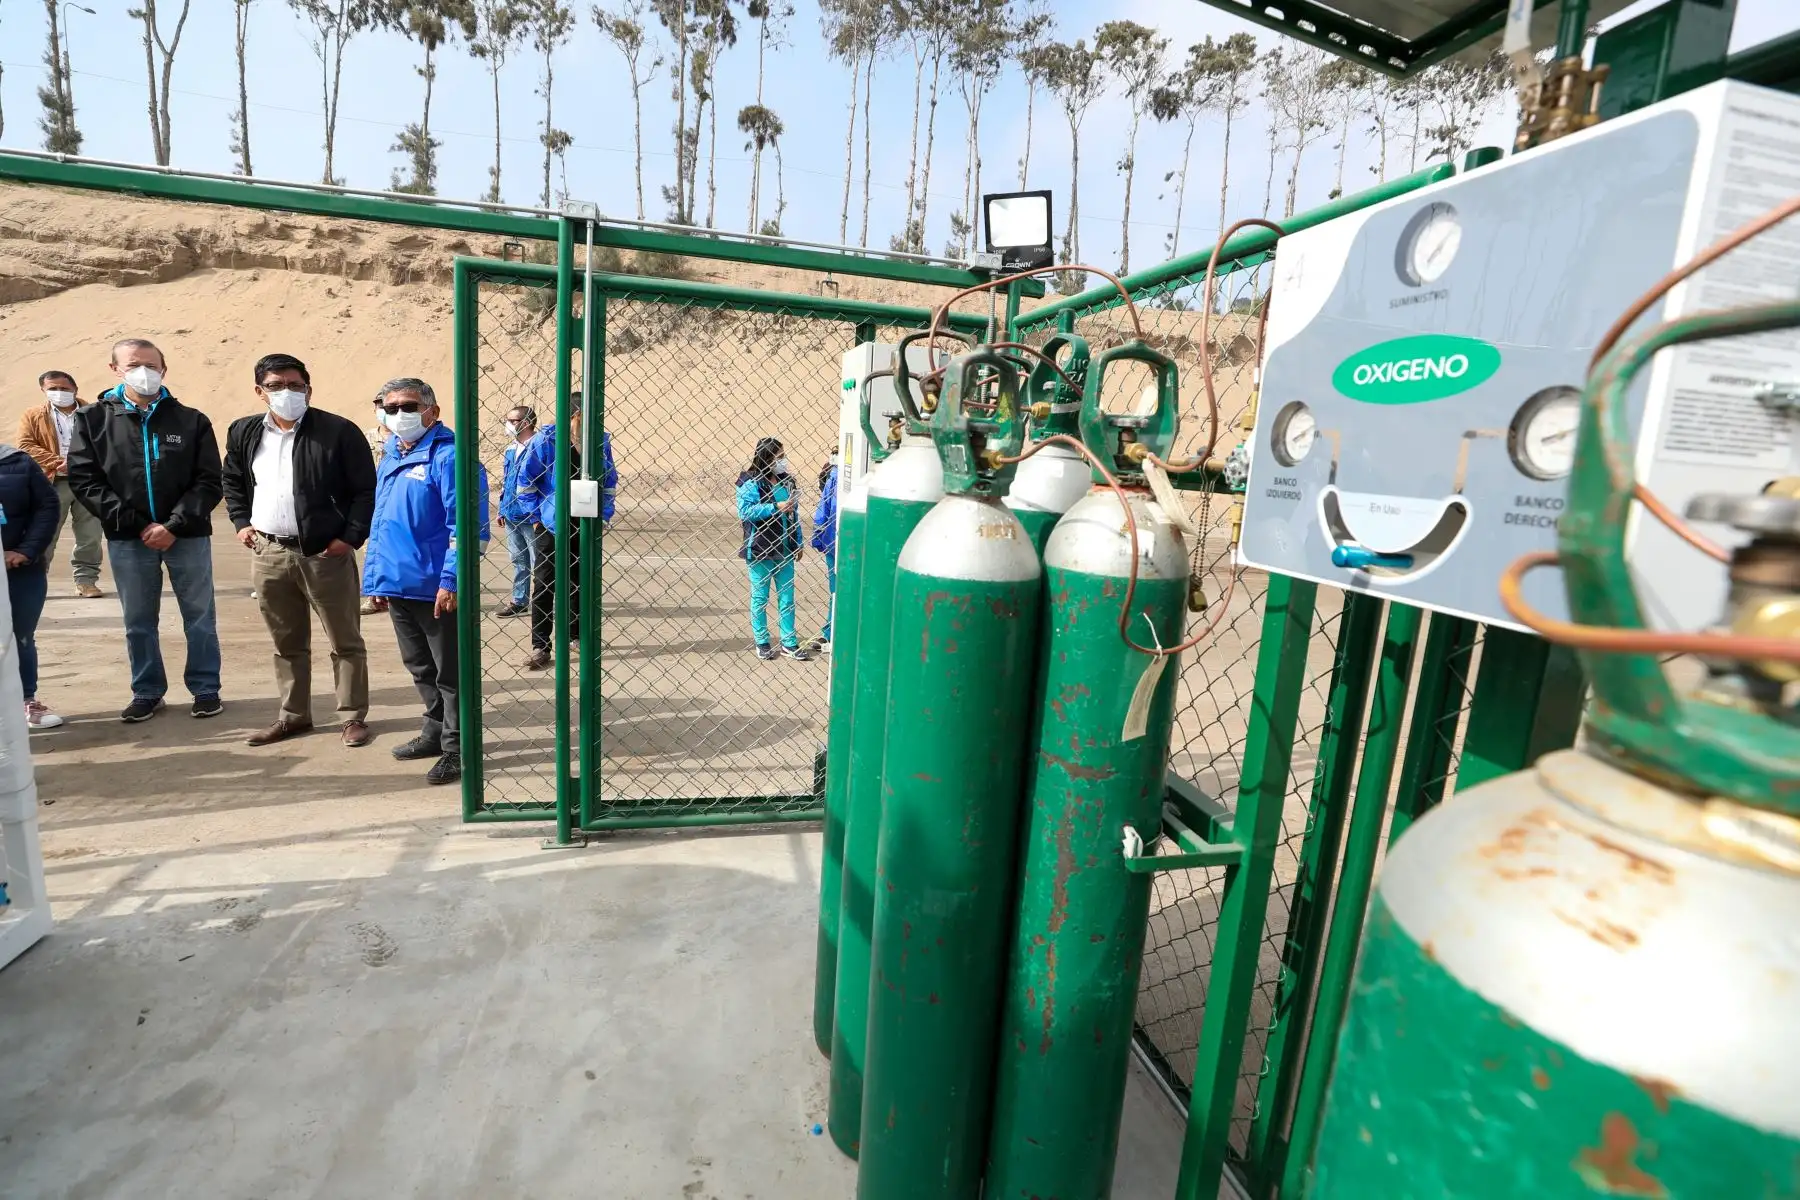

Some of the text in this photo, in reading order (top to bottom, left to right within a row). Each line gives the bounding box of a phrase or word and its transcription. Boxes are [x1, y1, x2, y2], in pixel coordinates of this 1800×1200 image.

[1389, 289, 1449, 309] SUMINISTRO
[1353, 354, 1469, 385] OXIGENO
[1273, 477, 1298, 487] BANCO
[1265, 488, 1302, 501] IZQUIERDO
[1515, 495, 1565, 510] BANCO
[1504, 512, 1559, 529] DERECH
